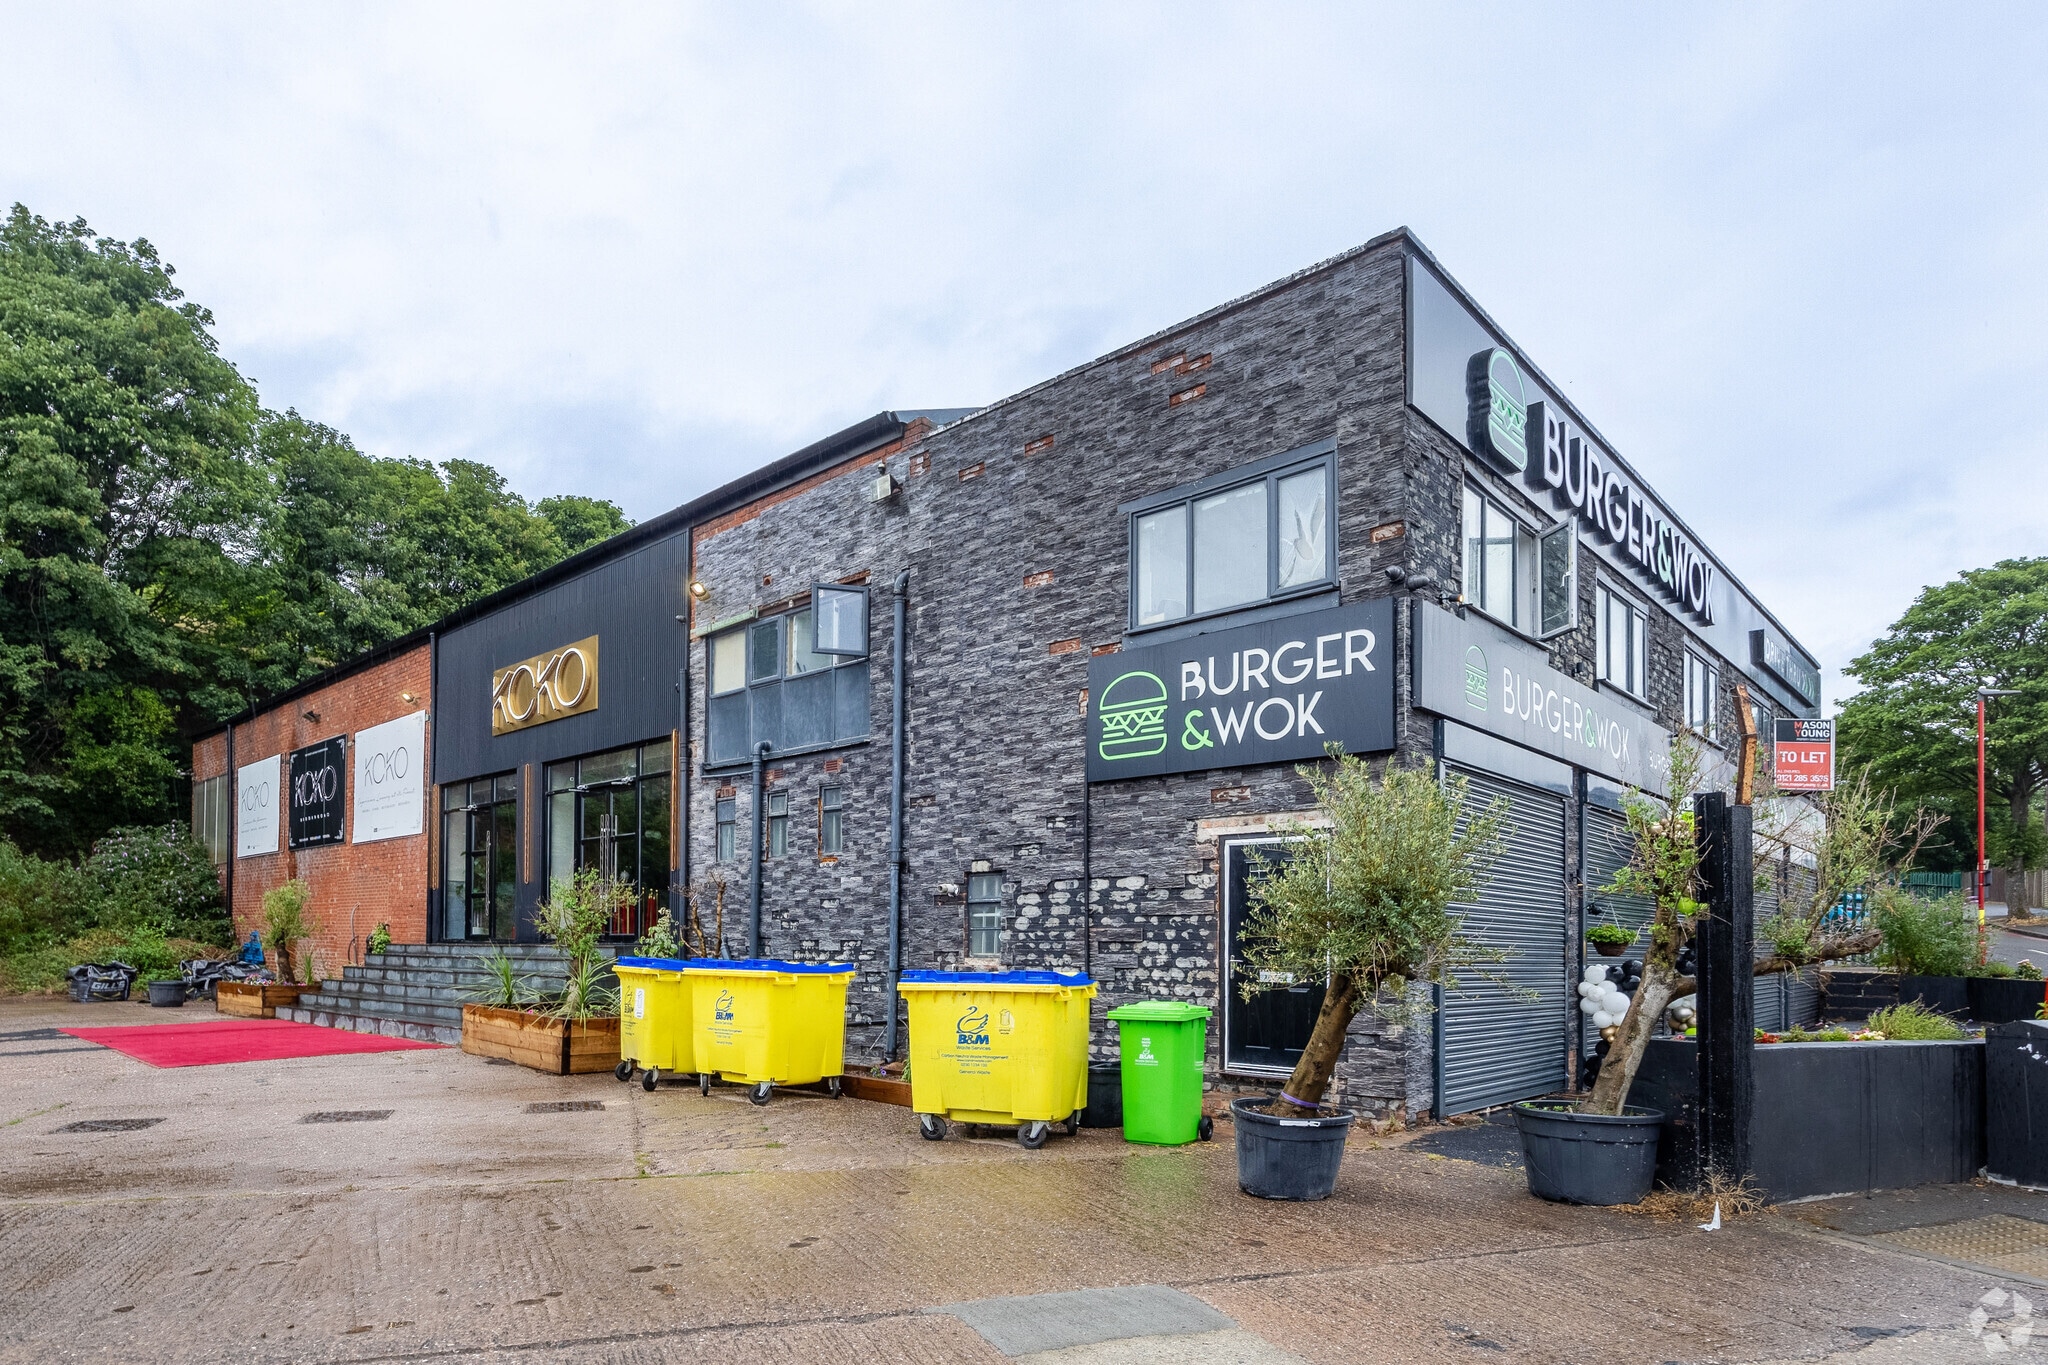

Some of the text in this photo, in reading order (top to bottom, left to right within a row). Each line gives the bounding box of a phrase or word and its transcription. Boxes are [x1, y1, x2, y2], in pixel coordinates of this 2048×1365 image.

[1181, 628, 1376, 702] BURGER
[493, 647, 589, 727] KOKO
[1181, 690, 1325, 751] &WOK
[1794, 721, 1830, 730] MASON
[1795, 729, 1830, 738] YOUNG
[364, 746, 409, 787] KOKO
[1780, 750, 1827, 763] TO LET
[294, 765, 337, 808] KOKO
[1793, 774, 1808, 783] 285
[241, 781, 270, 813] KOKO
[958, 1034, 990, 1044] B&M
